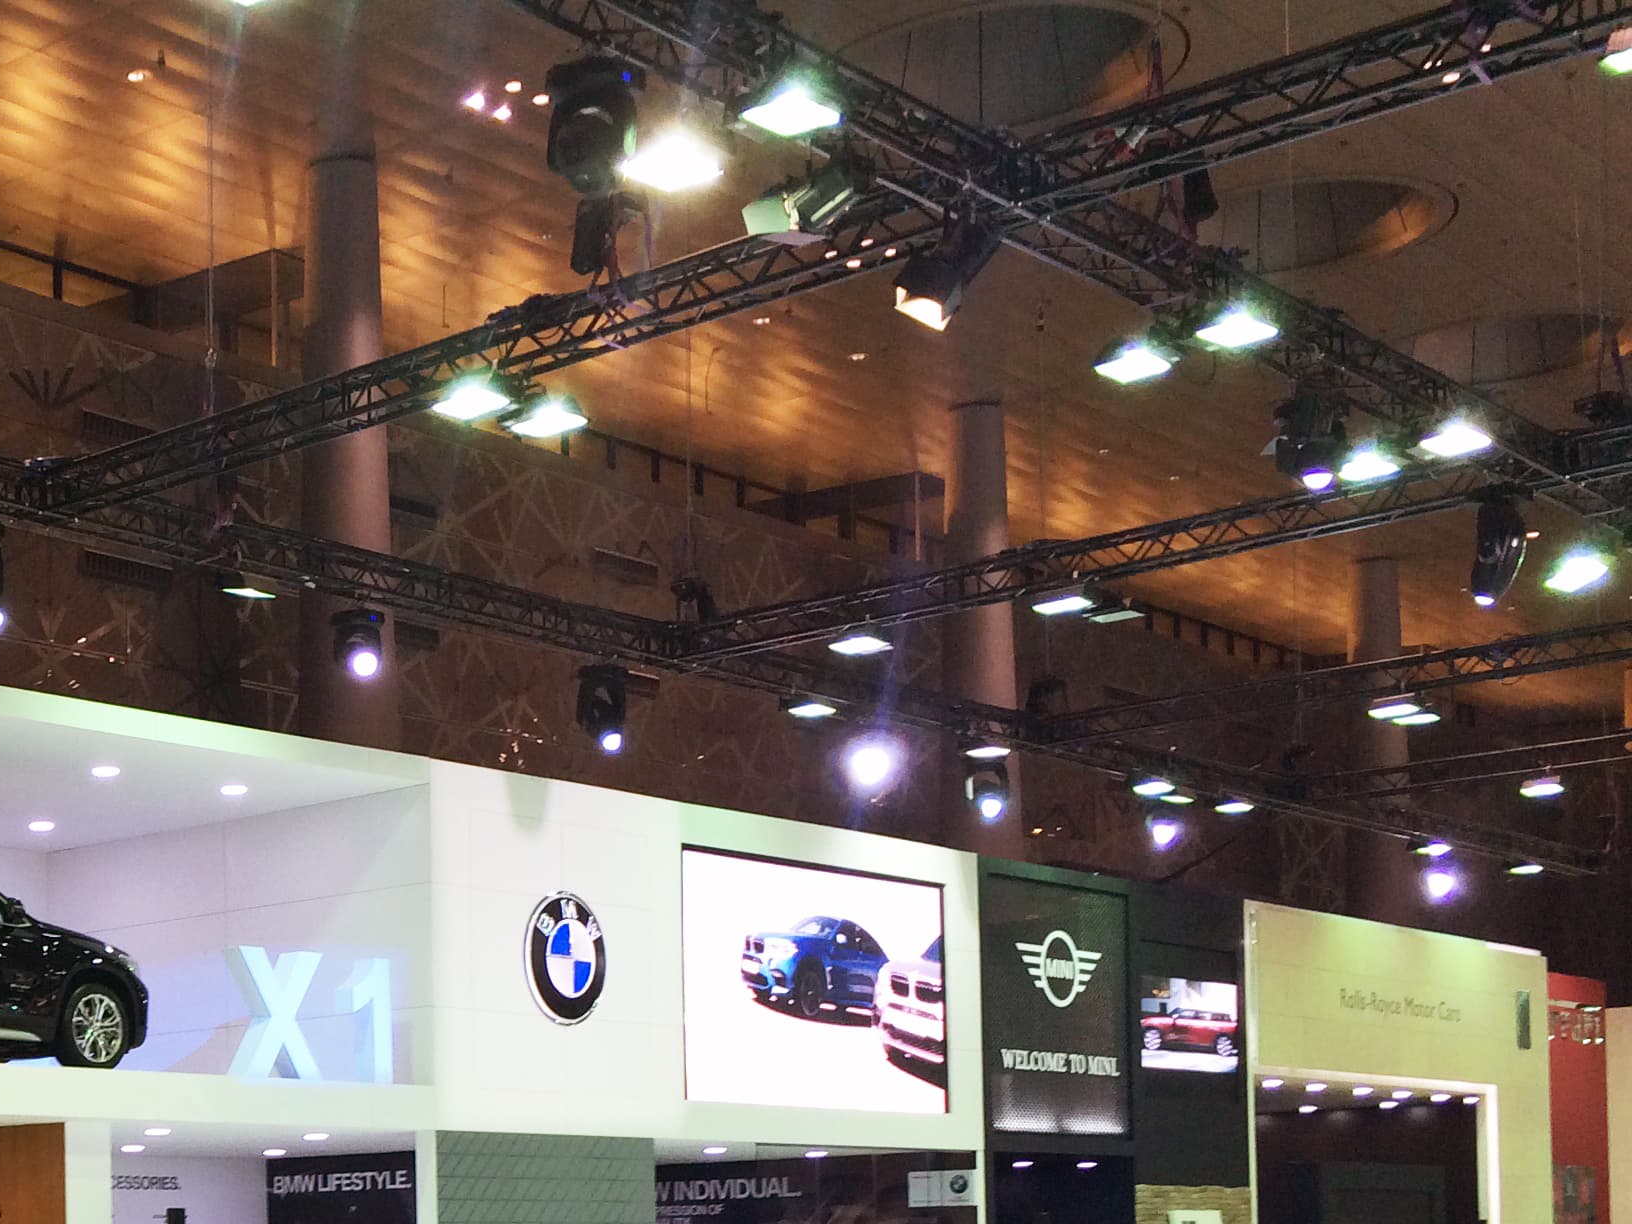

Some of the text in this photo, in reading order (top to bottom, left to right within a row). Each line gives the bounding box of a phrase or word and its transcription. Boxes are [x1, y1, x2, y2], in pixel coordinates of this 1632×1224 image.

[536, 898, 603, 942] BMW
[1045, 957, 1074, 980] MINI
[224, 944, 394, 1085] X1
[1000, 1048, 1068, 1073] WELCOME
[1069, 1053, 1087, 1075] TO
[272, 1173, 316, 1195] BMW
[673, 1176, 803, 1201] INDIVIDUAL.
